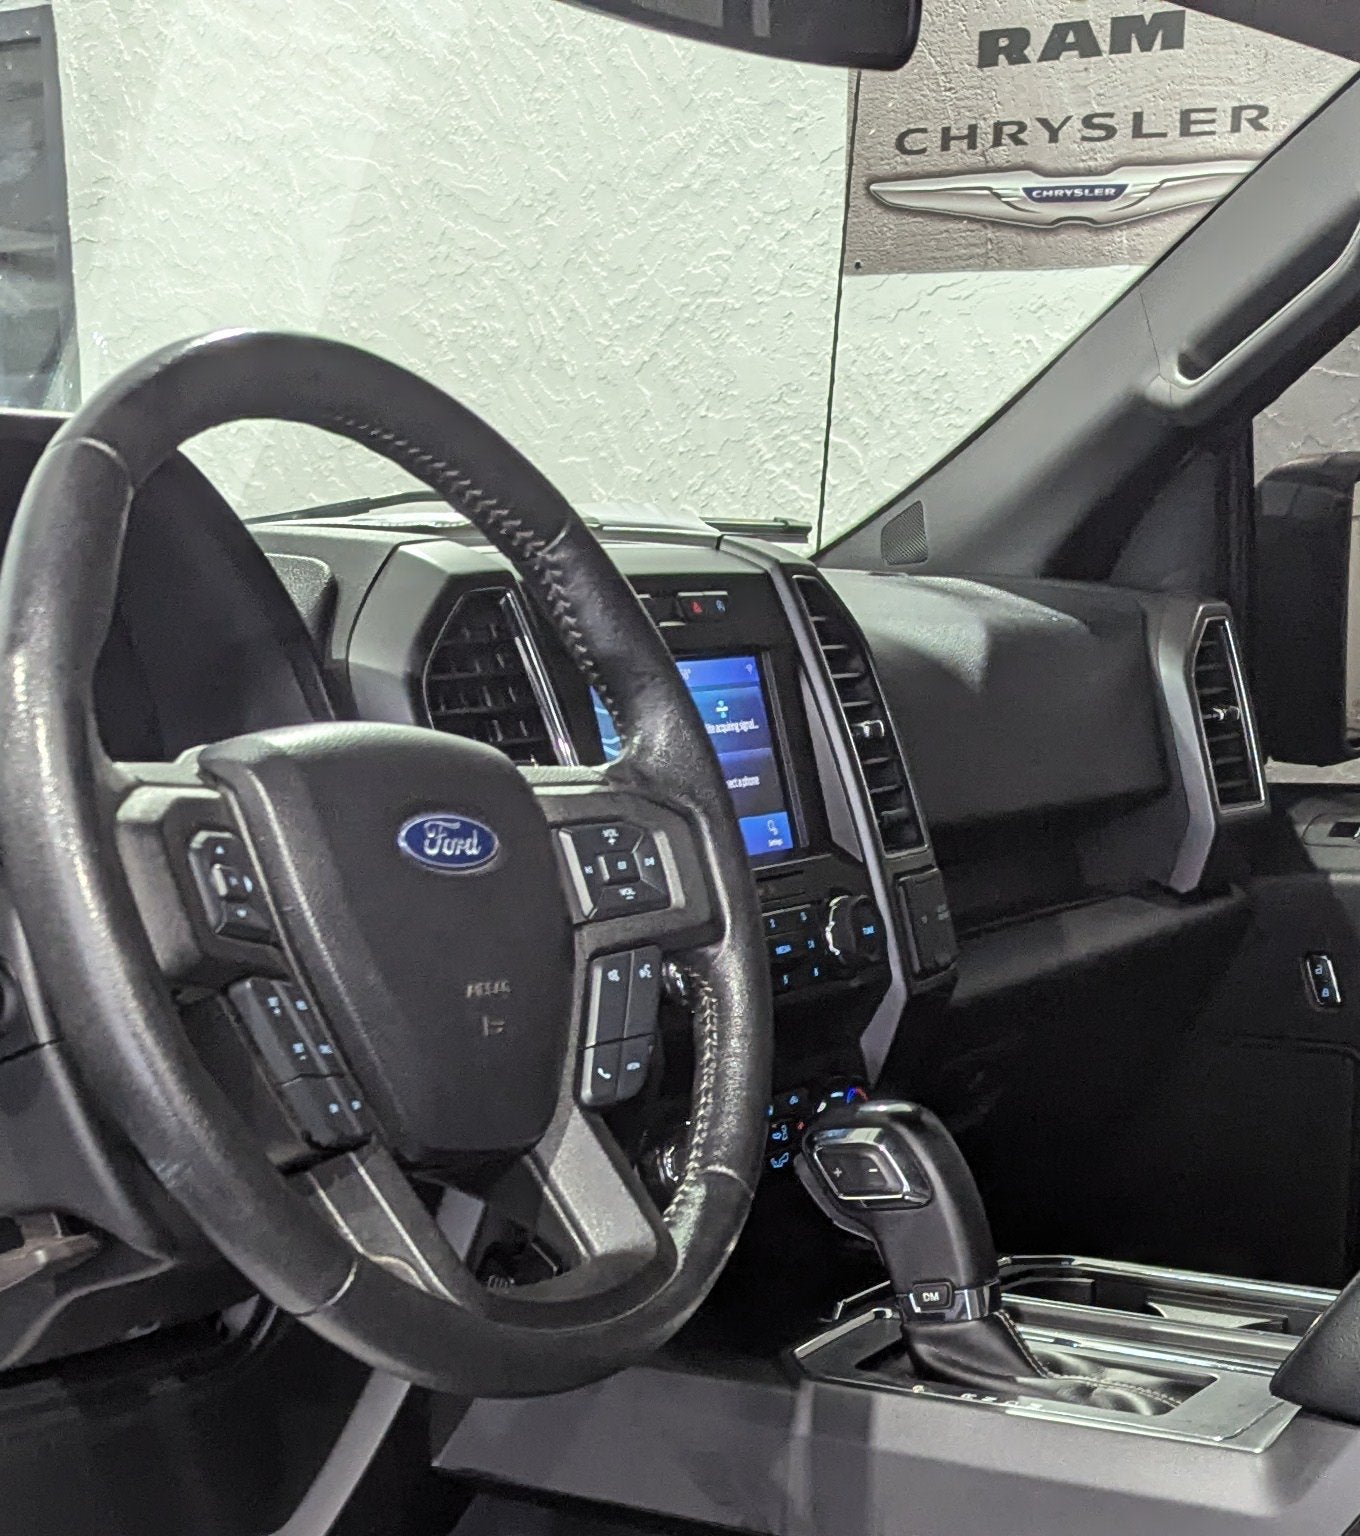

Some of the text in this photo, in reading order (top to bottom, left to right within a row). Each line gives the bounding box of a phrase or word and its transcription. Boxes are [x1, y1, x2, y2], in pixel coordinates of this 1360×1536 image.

[977, 10, 1186, 68] RAM
[896, 105, 1270, 156] CHRYSLER
[1032, 188, 1117, 198] CHRYSLER
[423, 820, 482, 857] Ford
